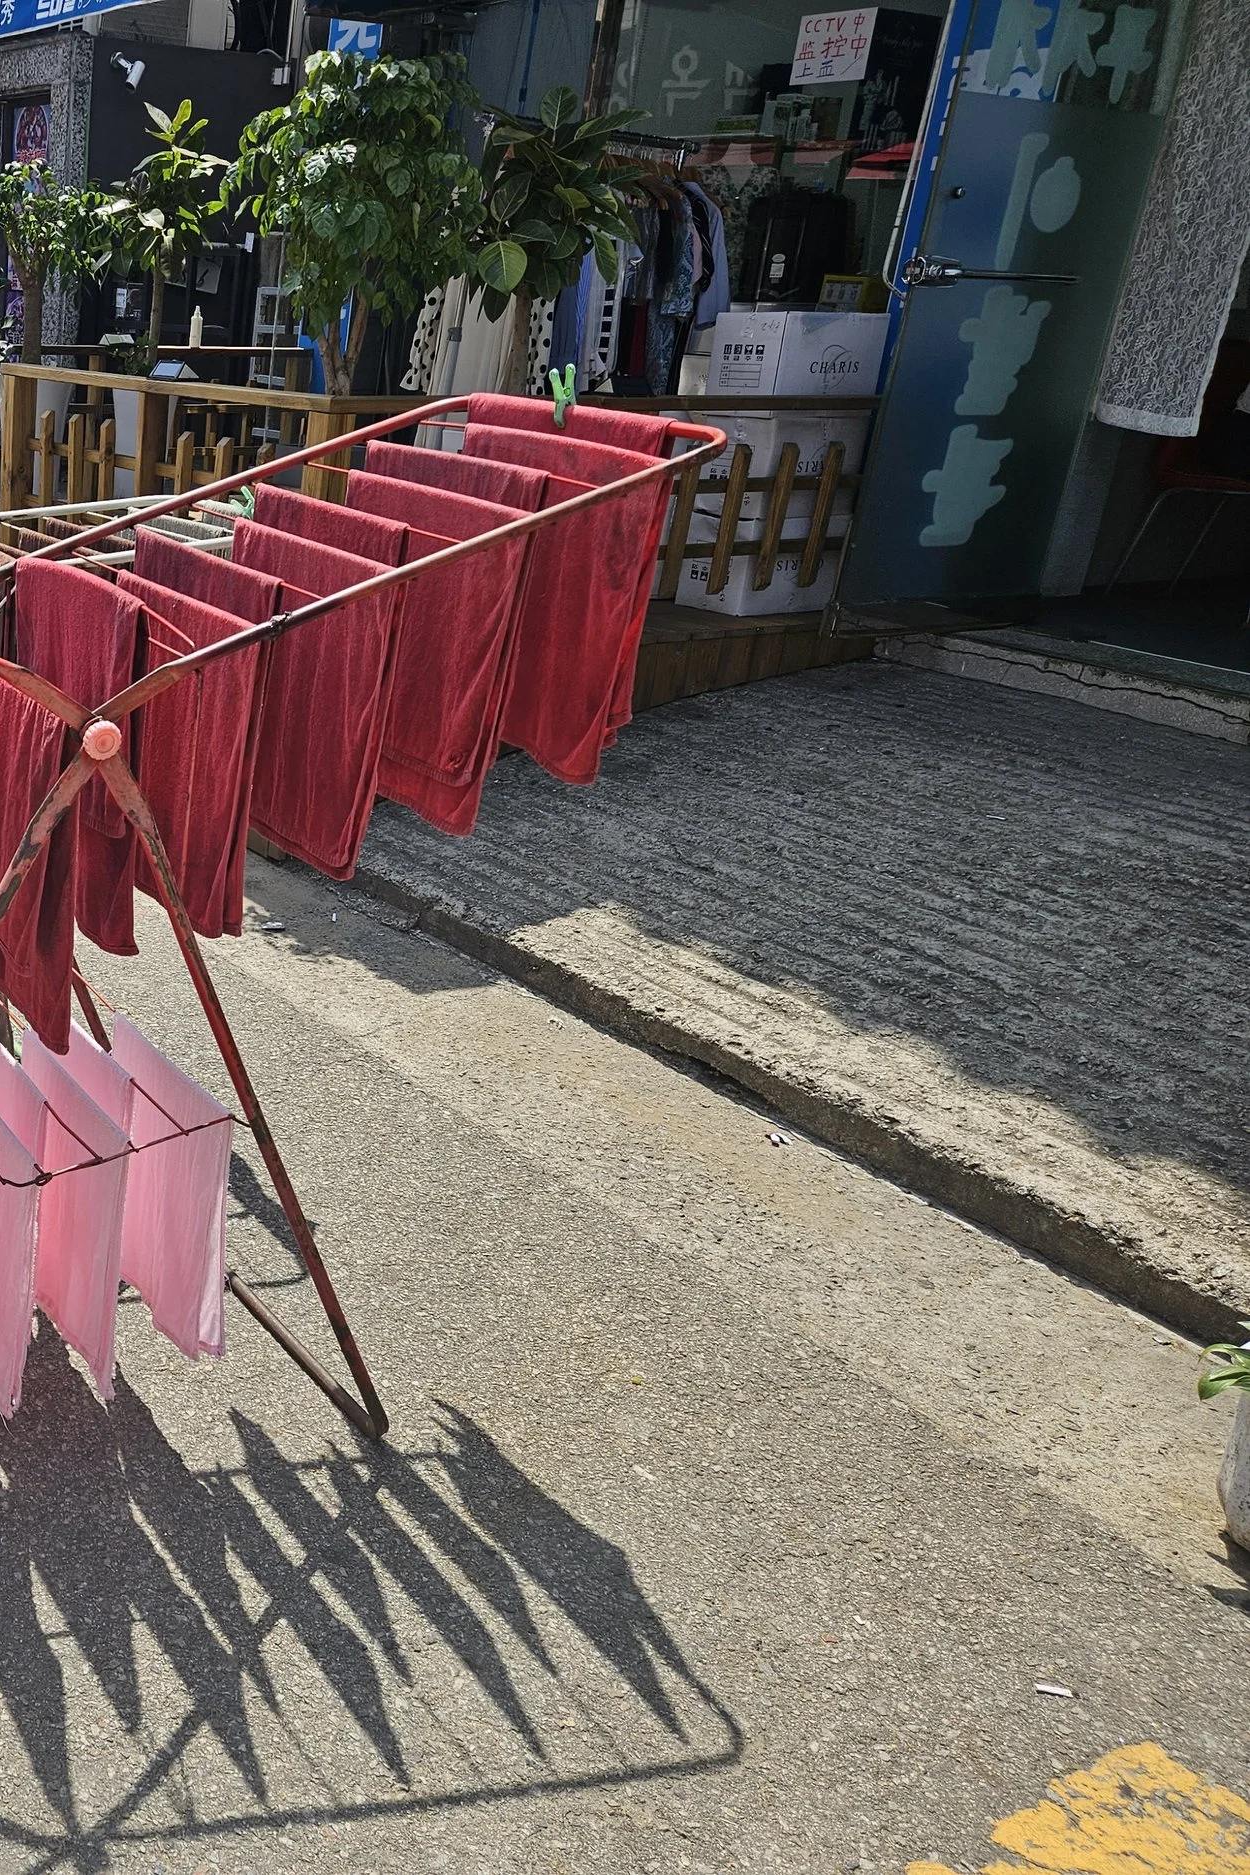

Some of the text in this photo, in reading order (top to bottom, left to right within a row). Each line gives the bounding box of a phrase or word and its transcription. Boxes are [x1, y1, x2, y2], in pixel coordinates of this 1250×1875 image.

[804, 16, 847, 34] CCTV
[795, 33, 868, 61] 监控中
[809, 360, 860, 375] CHARIS
